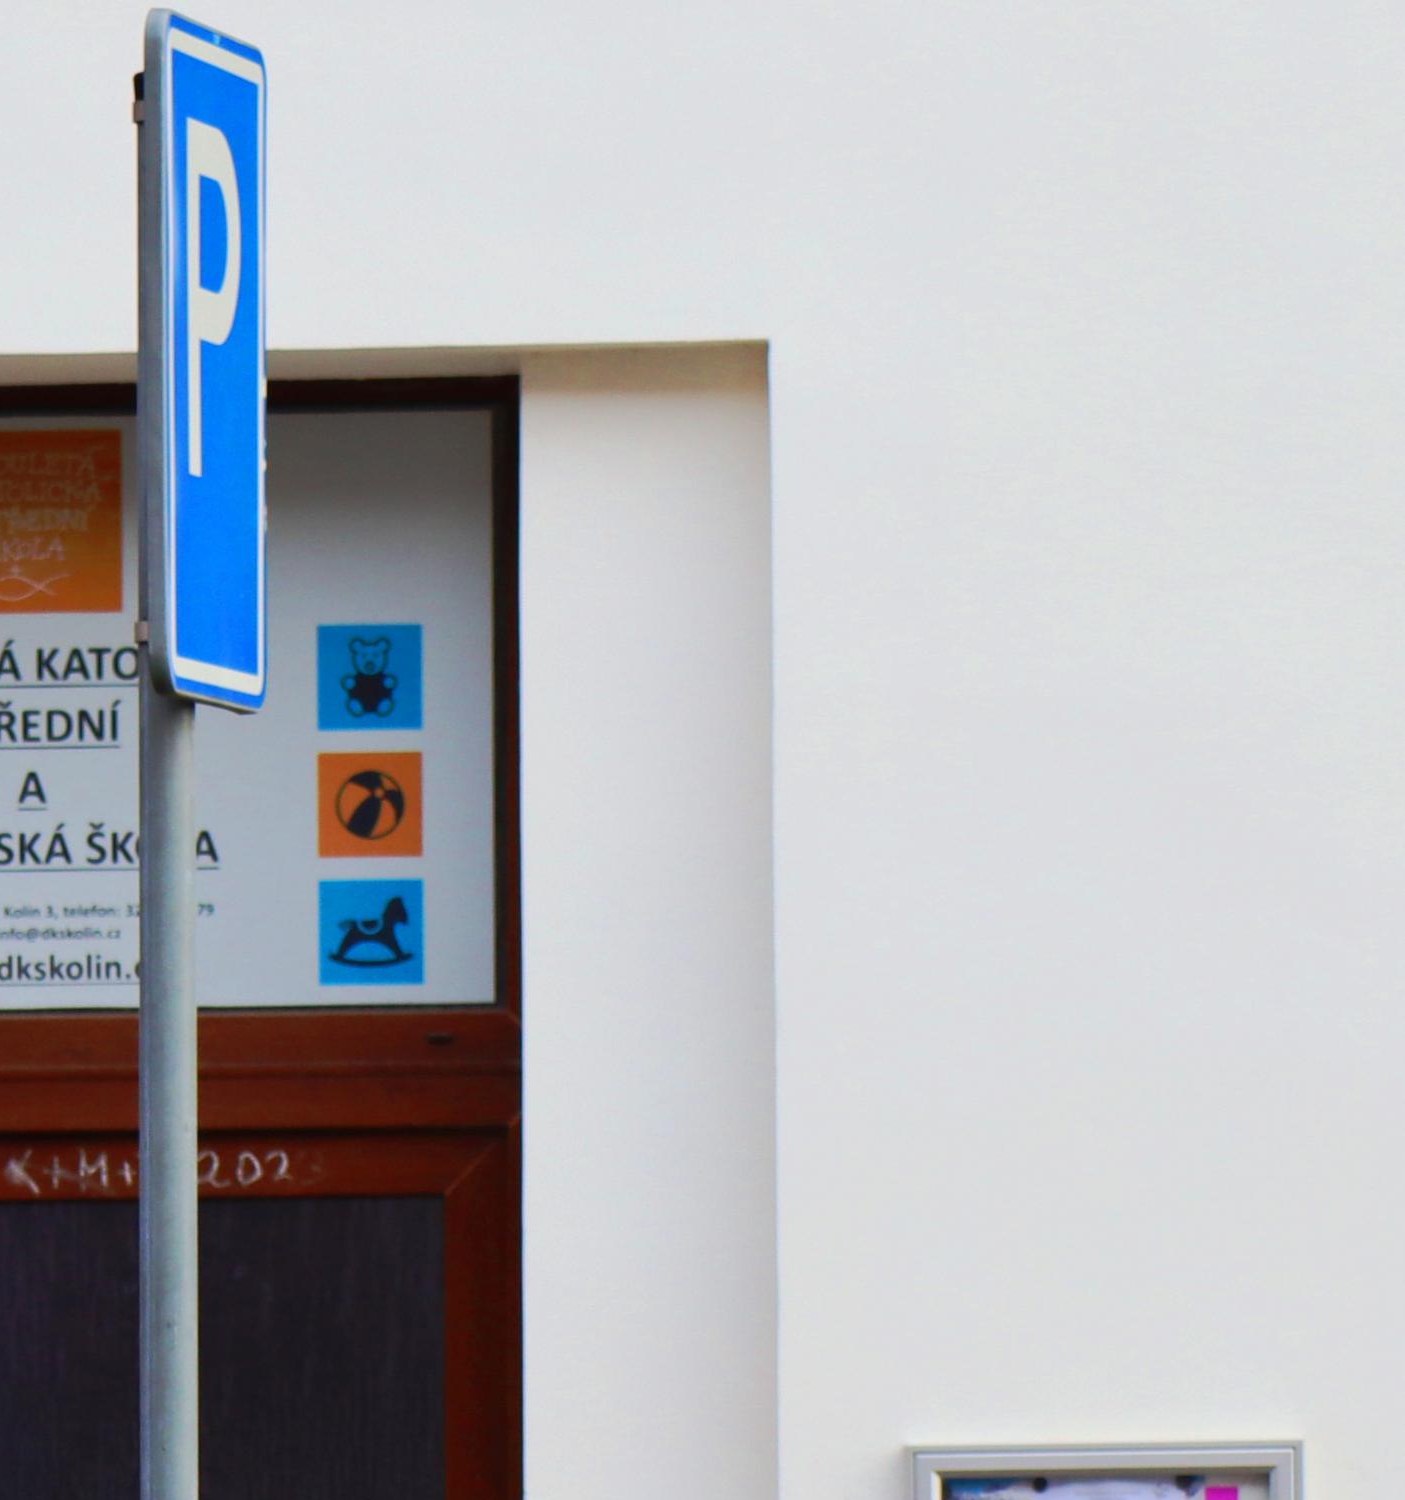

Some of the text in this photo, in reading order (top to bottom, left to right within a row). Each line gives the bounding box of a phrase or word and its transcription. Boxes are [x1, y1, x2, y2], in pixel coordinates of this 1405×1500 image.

[186, 116, 241, 477] P
[18, 772, 47, 804] A
[85, 822, 219, 865] ŠKA
